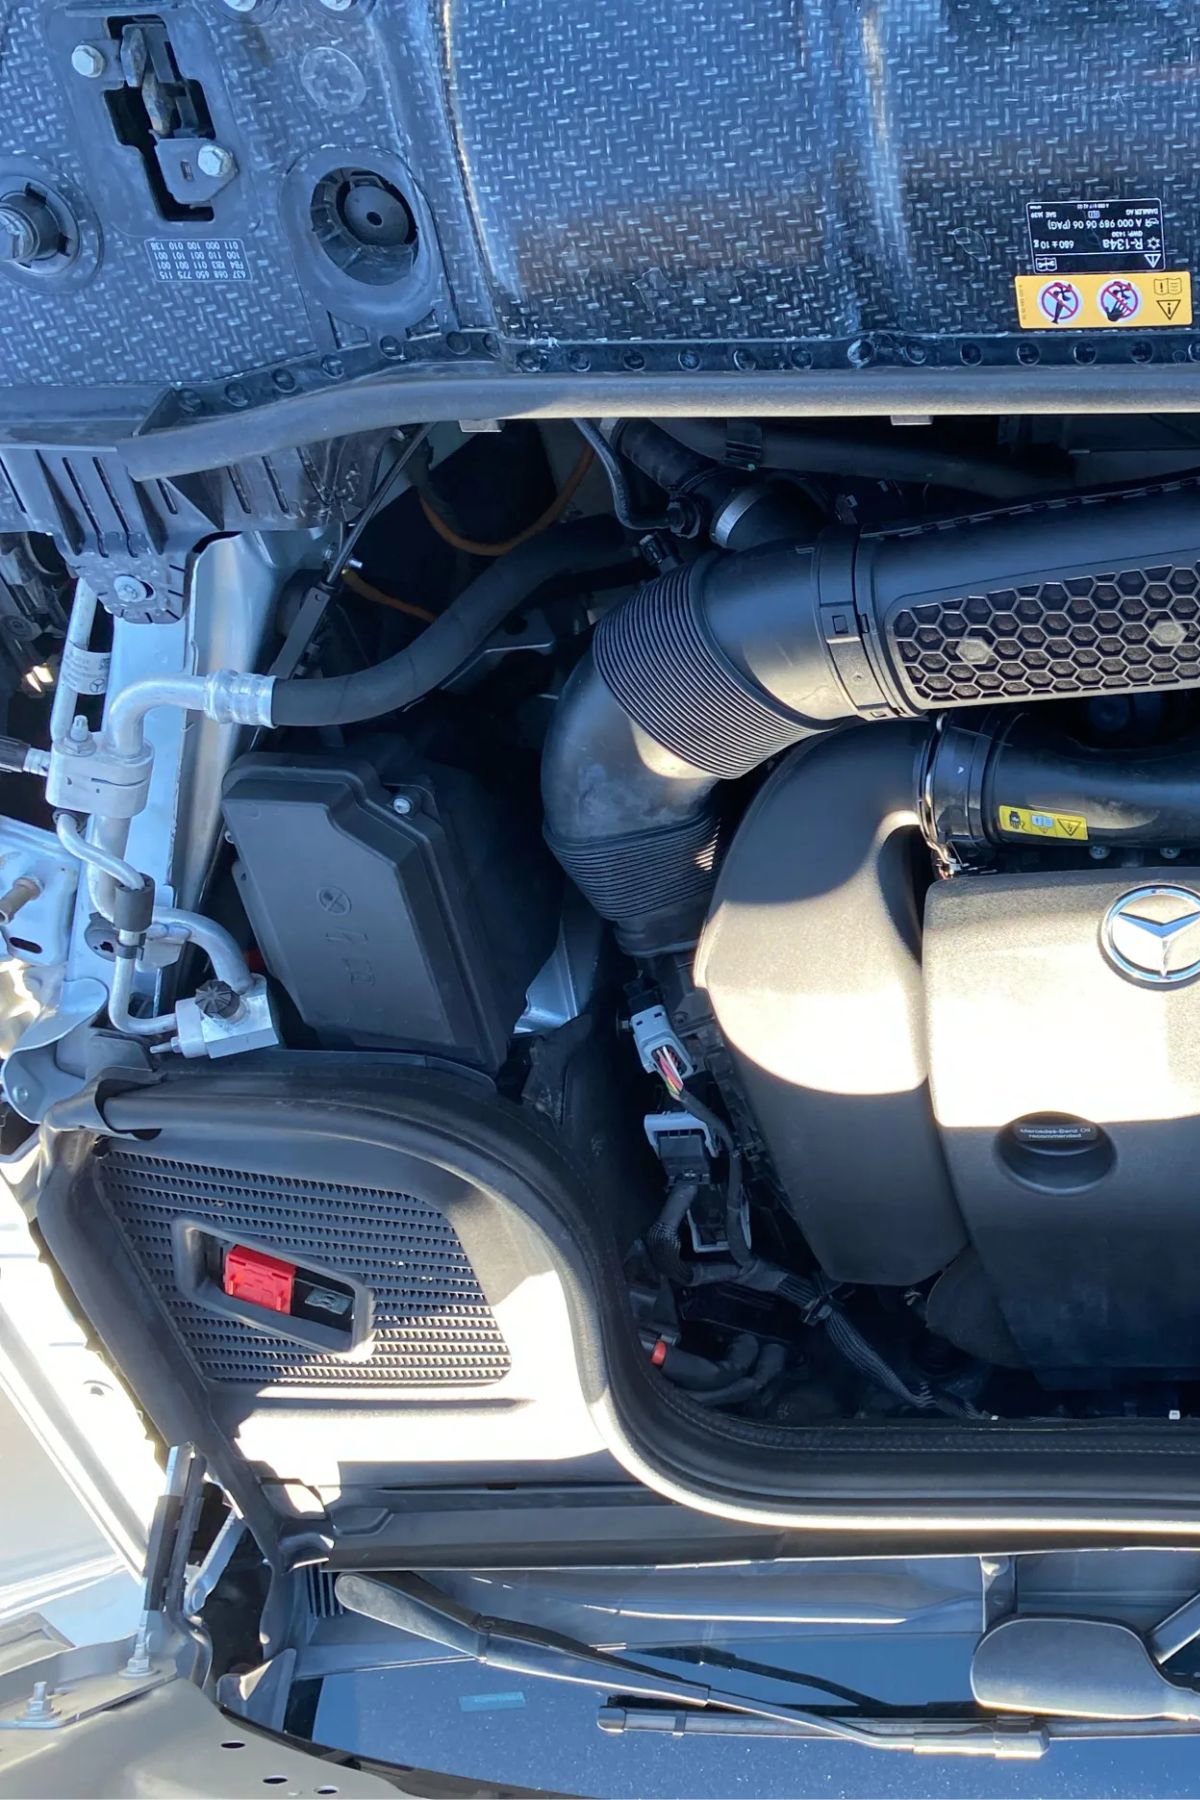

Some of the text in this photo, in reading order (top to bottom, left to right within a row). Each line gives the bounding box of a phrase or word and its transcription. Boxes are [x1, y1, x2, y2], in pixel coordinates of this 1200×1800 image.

[1048, 220, 1071, 229] (PAG)
[1117, 219, 1134, 227] 000
[1136, 218, 1142, 227] A
[1033, 240, 1039, 248] g
[1059, 240, 1074, 248] 680
[1102, 238, 1143, 250] R-134a
